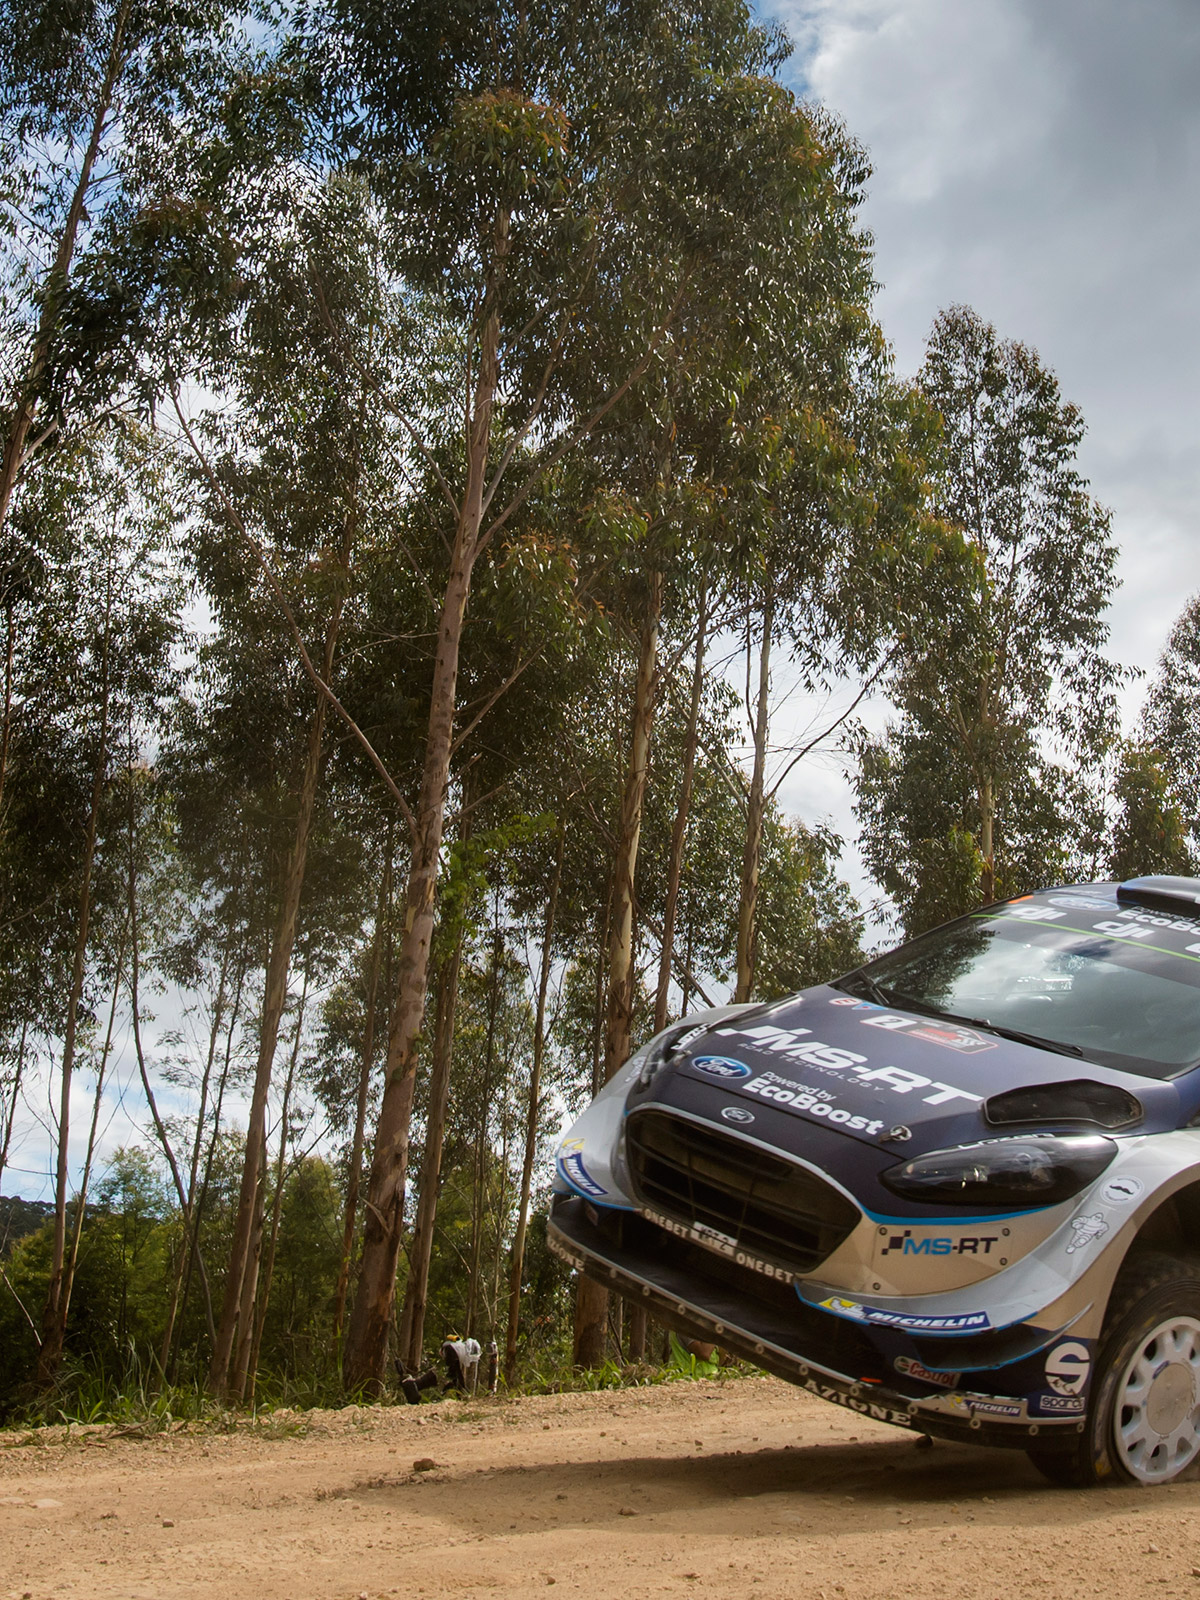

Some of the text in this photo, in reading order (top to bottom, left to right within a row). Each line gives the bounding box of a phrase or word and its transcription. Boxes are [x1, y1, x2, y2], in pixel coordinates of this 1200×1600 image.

[1130, 905, 1196, 922] Powered
[697, 1057, 744, 1077] Ford
[737, 1042, 885, 1092] ROAD TECHNOLOGY
[751, 1032, 985, 1106] MS-RT
[760, 1070, 838, 1102] Powered by
[742, 1077, 885, 1136] EcoBoost
[566, 1158, 605, 1195] MICHELIN
[644, 1208, 689, 1239] ONEBET
[903, 1236, 998, 1256] MS-RT
[735, 1252, 794, 1284] ONEBET
[868, 1311, 986, 1328] MICHELIN
[908, 1362, 956, 1388] Castrol
[969, 1401, 1020, 1415] MICHELIN
